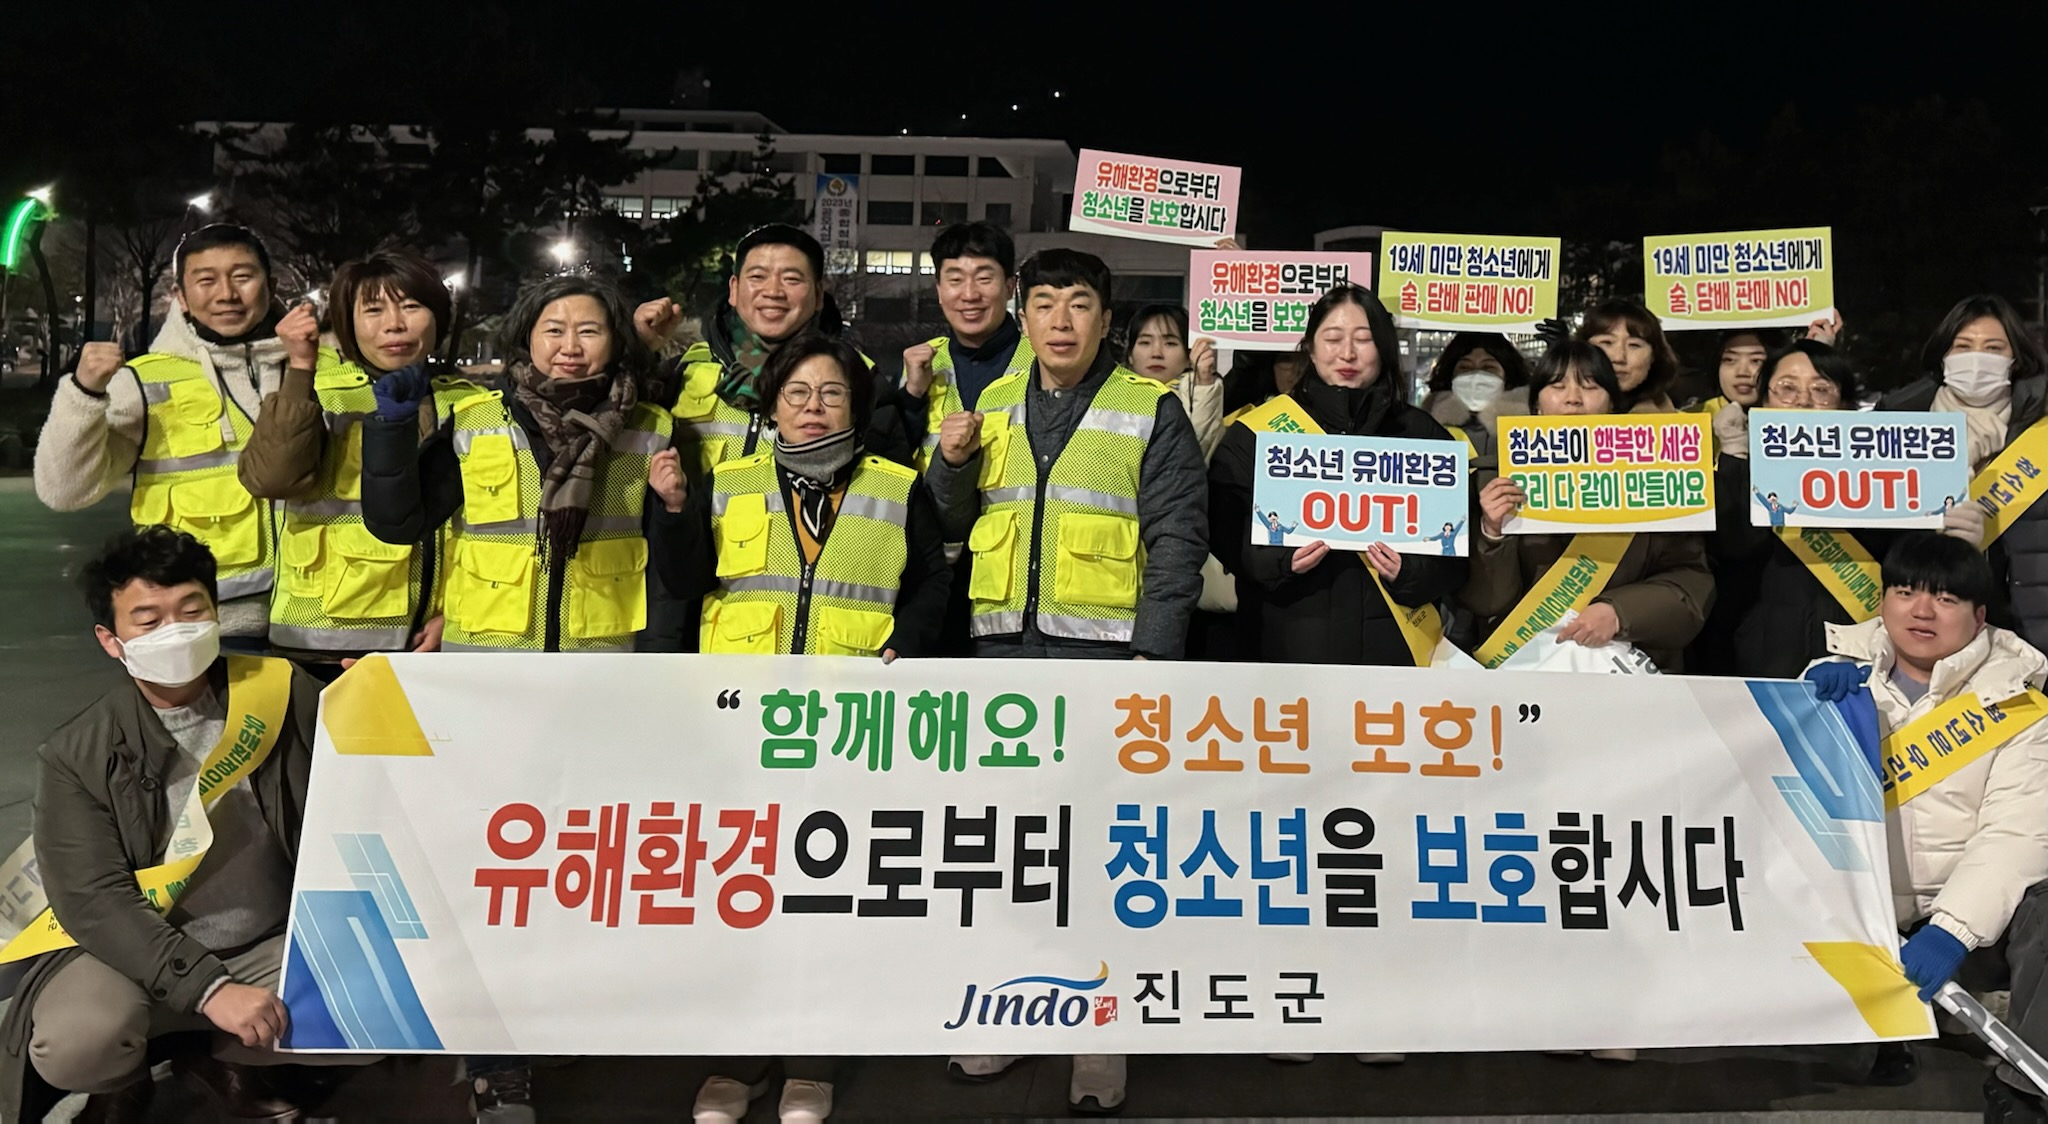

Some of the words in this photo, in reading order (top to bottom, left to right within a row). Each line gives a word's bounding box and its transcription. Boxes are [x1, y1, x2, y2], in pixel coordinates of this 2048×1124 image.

[1097, 162, 1220, 200] 유해환경으로부터
[1082, 191, 1144, 223] 청소년을
[1148, 200, 1226, 232] 보호합시다
[1390, 244, 1424, 275] 19세
[1429, 246, 1463, 276] 미만
[1466, 247, 1551, 280] 청소년에게
[1653, 246, 1689, 276] 19세
[1696, 244, 1729, 275] 미만
[1734, 239, 1822, 273] 청소년에게
[1199, 299, 1267, 332] 청소년을
[1273, 300, 1314, 332] 보호
[1400, 281, 1422, 313] 술,
[1427, 283, 1459, 313] 담배
[1464, 284, 1497, 314] 판매
[1502, 286, 1534, 315] NO!
[1670, 283, 1692, 316] 술,
[1697, 281, 1730, 312] 담배
[1736, 279, 1769, 310] 판매
[1775, 278, 1808, 308] NO!
[1510, 429, 1589, 464] 청소년이
[1594, 426, 1655, 464] 행복한
[1661, 426, 1701, 462] 세상
[1762, 425, 1841, 458] 청소년
[1850, 426, 1955, 459] 유해환경
[1267, 446, 1343, 481] 청소년
[1352, 450, 1457, 487] 유해환경
[1554, 472, 1574, 509] 다
[1580, 473, 1618, 508] 같이
[1625, 471, 1705, 507] 만들어요
[1802, 469, 1919, 509] OUT!
[1302, 493, 1419, 535] OUT!
[1113, 693, 1311, 775] 청소년
[474, 802, 1070, 928] 유해환경으로부터
[1104, 804, 1383, 928] 청소년을
[1410, 812, 1745, 931] 보호합시다
[944, 984, 1089, 1030] Jindo
